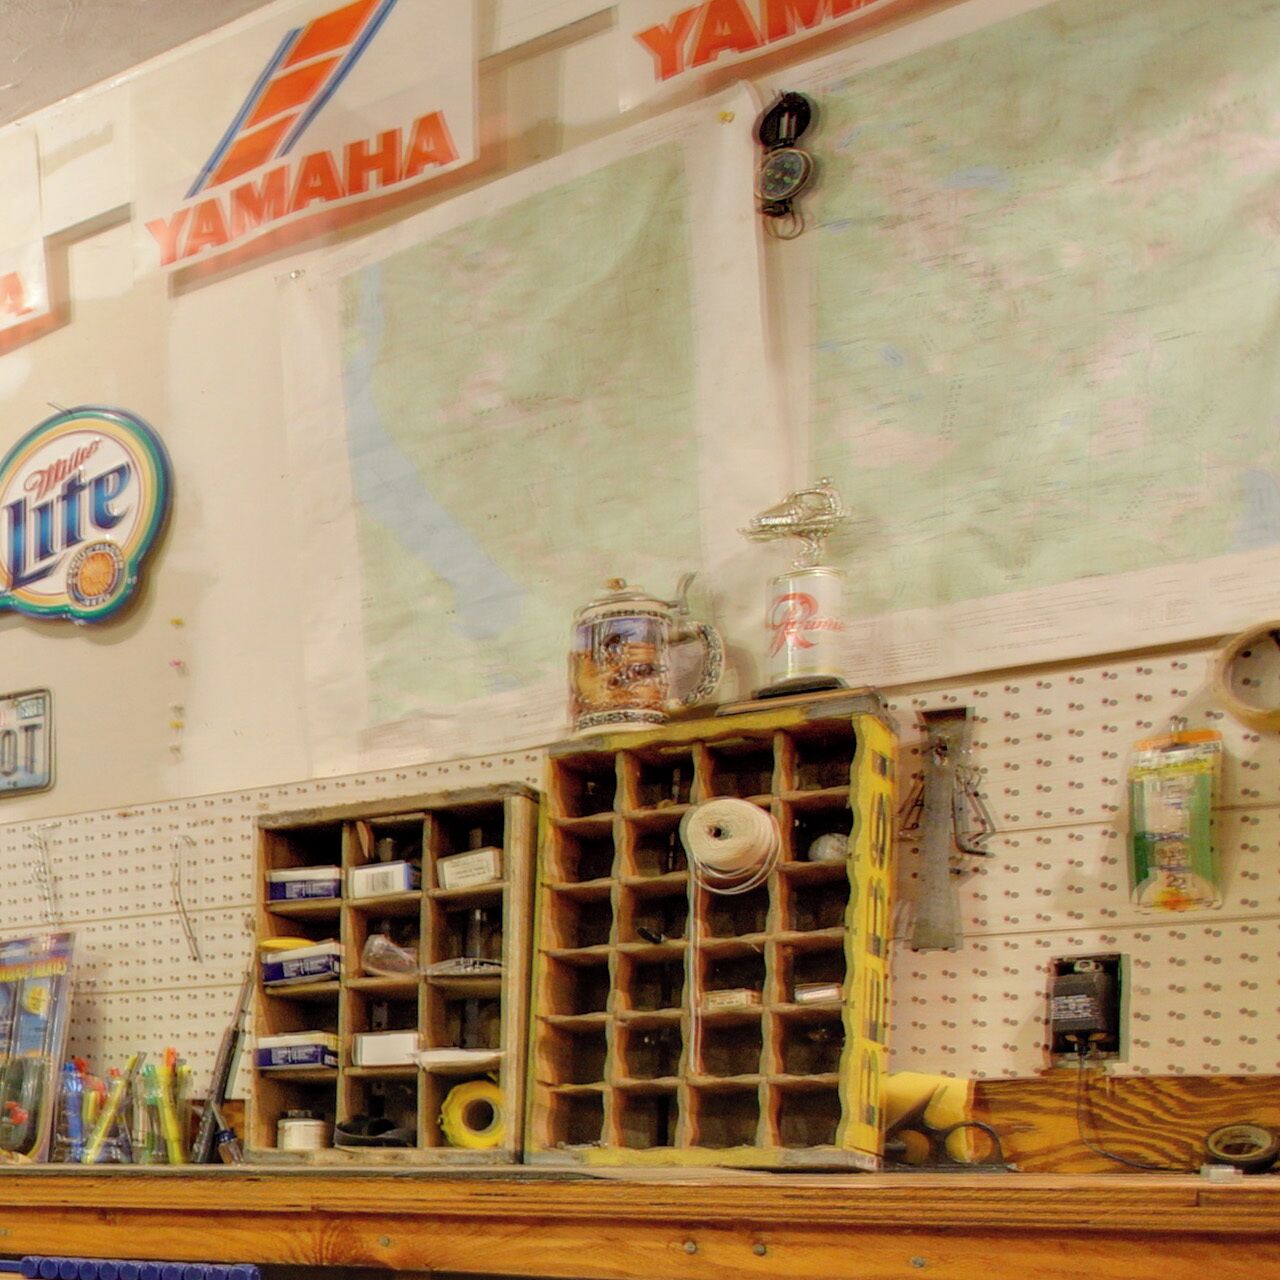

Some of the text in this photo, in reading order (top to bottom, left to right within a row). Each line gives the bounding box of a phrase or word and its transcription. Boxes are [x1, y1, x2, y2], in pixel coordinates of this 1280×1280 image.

[146, 109, 462, 267] YAMAHA
[3, 461, 132, 591] Lite
[24, 440, 102, 500] Miller
